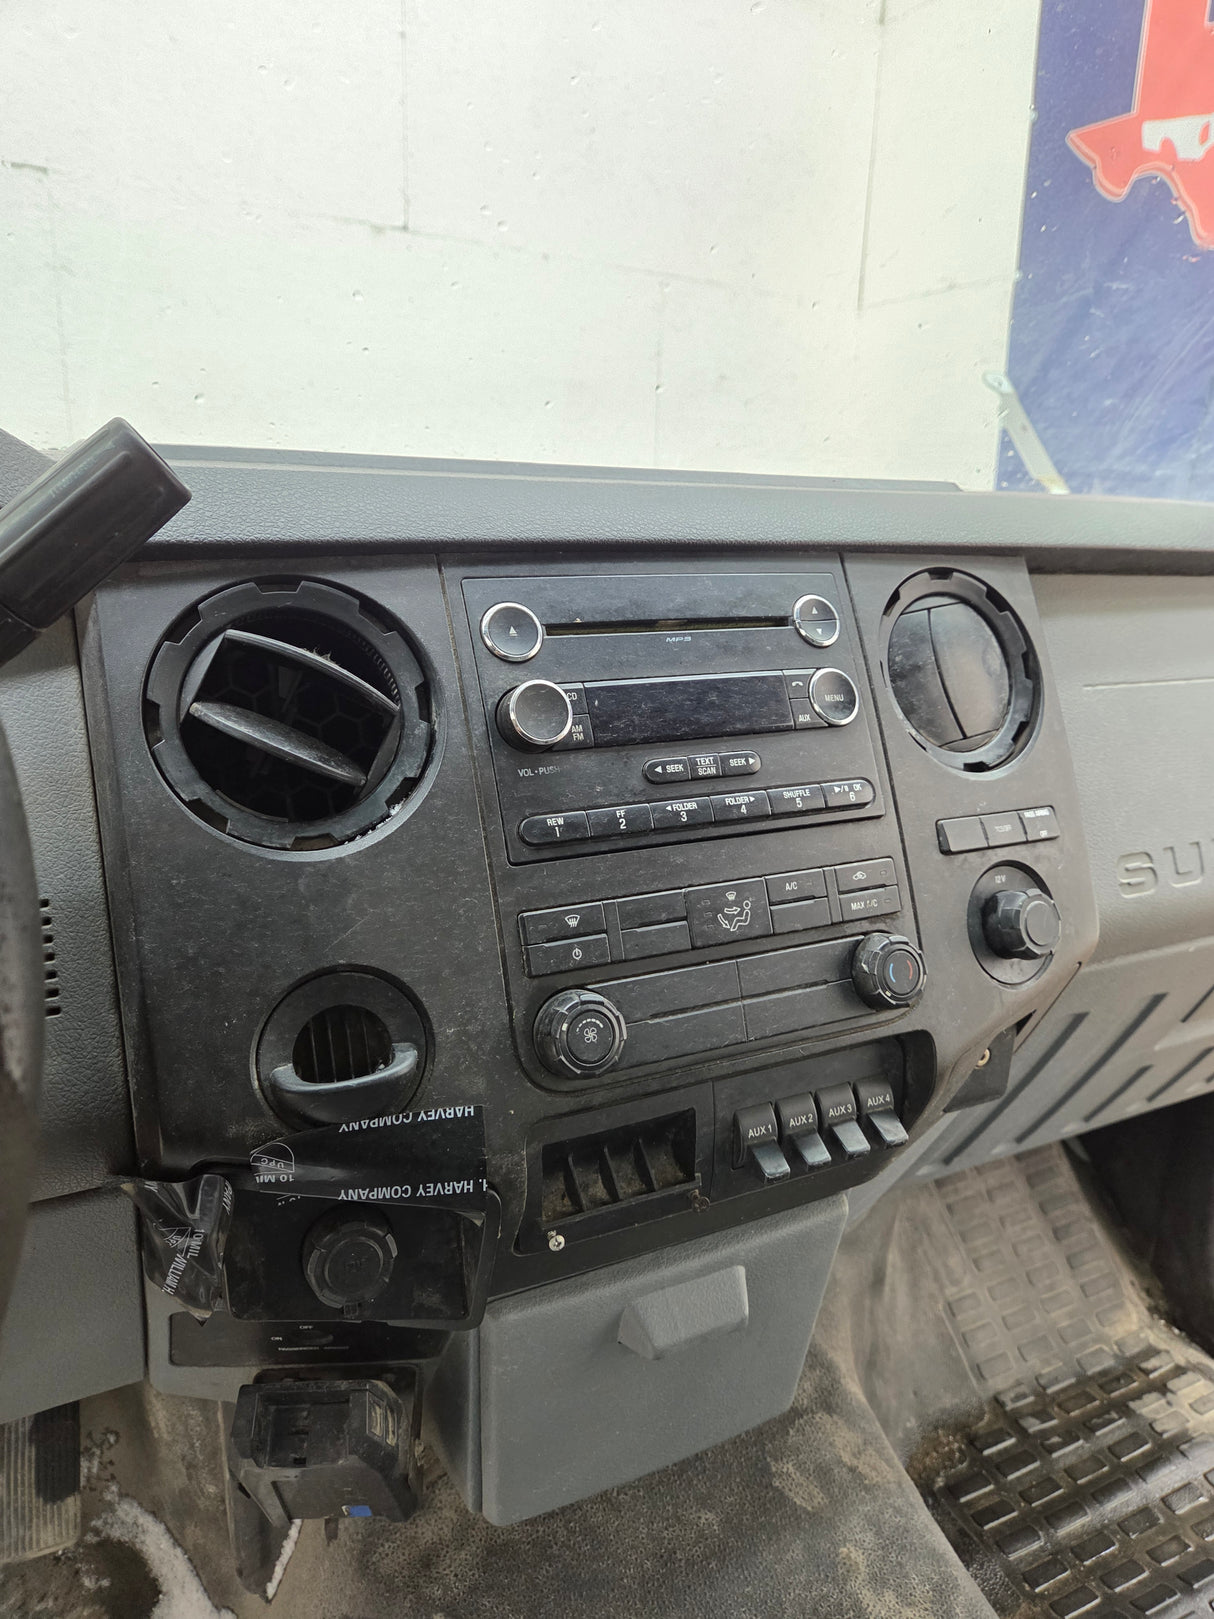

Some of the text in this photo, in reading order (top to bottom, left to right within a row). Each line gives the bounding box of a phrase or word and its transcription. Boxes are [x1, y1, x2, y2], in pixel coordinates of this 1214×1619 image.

[566, 692, 578, 700] CD
[824, 694, 844, 702] MENU
[798, 714, 811, 722] AUX
[571, 724, 583, 733] AM
[573, 732, 584, 741] FM
[695, 757, 714, 765] TEXT
[729, 758, 747, 767] SEEK
[666, 764, 684, 773] SEEK
[697, 766, 717, 776] SCAN
[782, 788, 811, 799] SHUFFLE
[849, 791, 856, 802] 6
[725, 796, 750, 806] FOLDER
[795, 797, 803, 808] 5
[672, 802, 698, 812] FOLDER
[740, 804, 747, 815] 4
[615, 810, 627, 818] FF
[680, 811, 688, 822] 3
[546, 817, 564, 826] REW
[618, 818, 627, 830] 2
[554, 826, 560, 838] 1
[1117, 838, 1214, 899] SU
[785, 881, 798, 891] A/C
[850, 898, 878, 911] MAX A/C
[867, 1093, 891, 1108] AUX 4
[828, 1103, 853, 1118] AUX 3
[339, 1105, 475, 1133] HARVEY COMPANY
[789, 1113, 814, 1128] AUX 2
[748, 1124, 773, 1138] AUX 1
[260, 1157, 284, 1168] UPC
[280, 1174, 295, 1182] 10
[338, 1185, 412, 1200] COMPANY
[416, 1180, 474, 1197] HARVEY
[186, 1229, 205, 1259] 10 MIL
